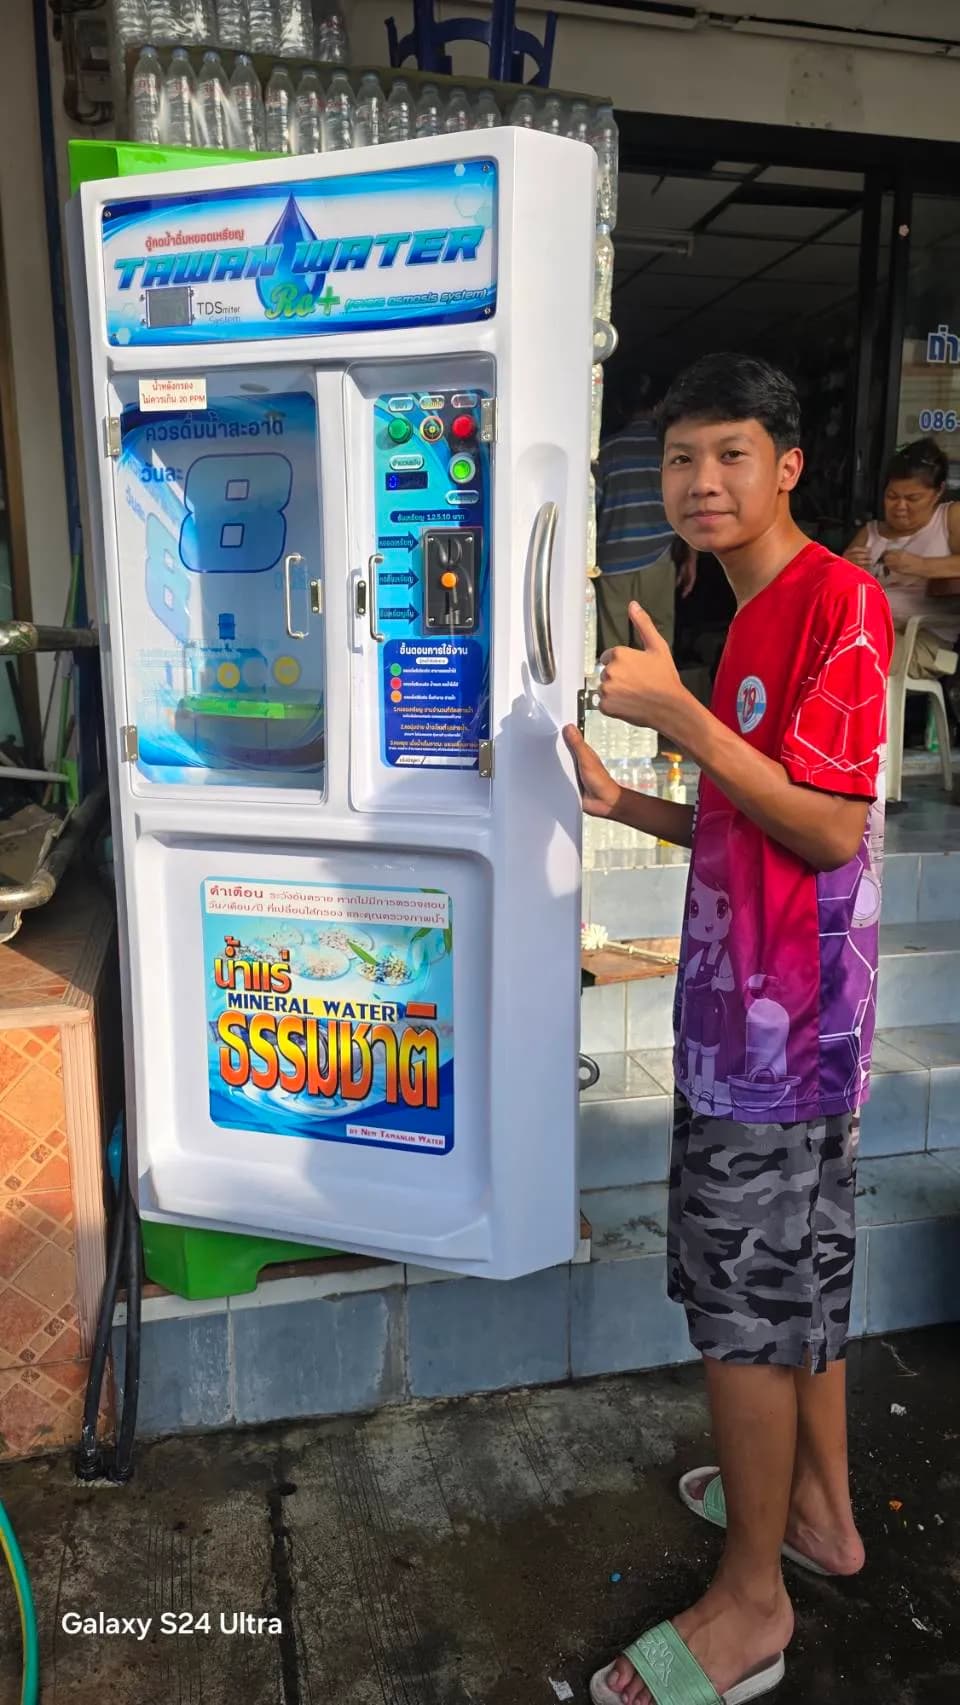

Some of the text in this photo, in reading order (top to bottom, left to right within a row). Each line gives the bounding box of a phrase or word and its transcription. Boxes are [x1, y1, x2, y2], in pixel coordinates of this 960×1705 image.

[114, 226, 485, 290] TAWAN WATER
[439, 288, 488, 303] system)
[926, 324, 960, 364] ถ่า
[145, 413, 284, 442] ควรดื่มน้ำสะอาด
[919, 409, 960, 431] 086-
[178, 452, 293, 573] 8
[399, 642, 468, 656] ขั้นตอนการใช้งาน
[210, 886, 264, 899] คำเตือน
[214, 935, 292, 994] น้ำแร่
[228, 992, 396, 1023] MINERAL WATER
[216, 1001, 440, 1109] ธรรมชาติ
